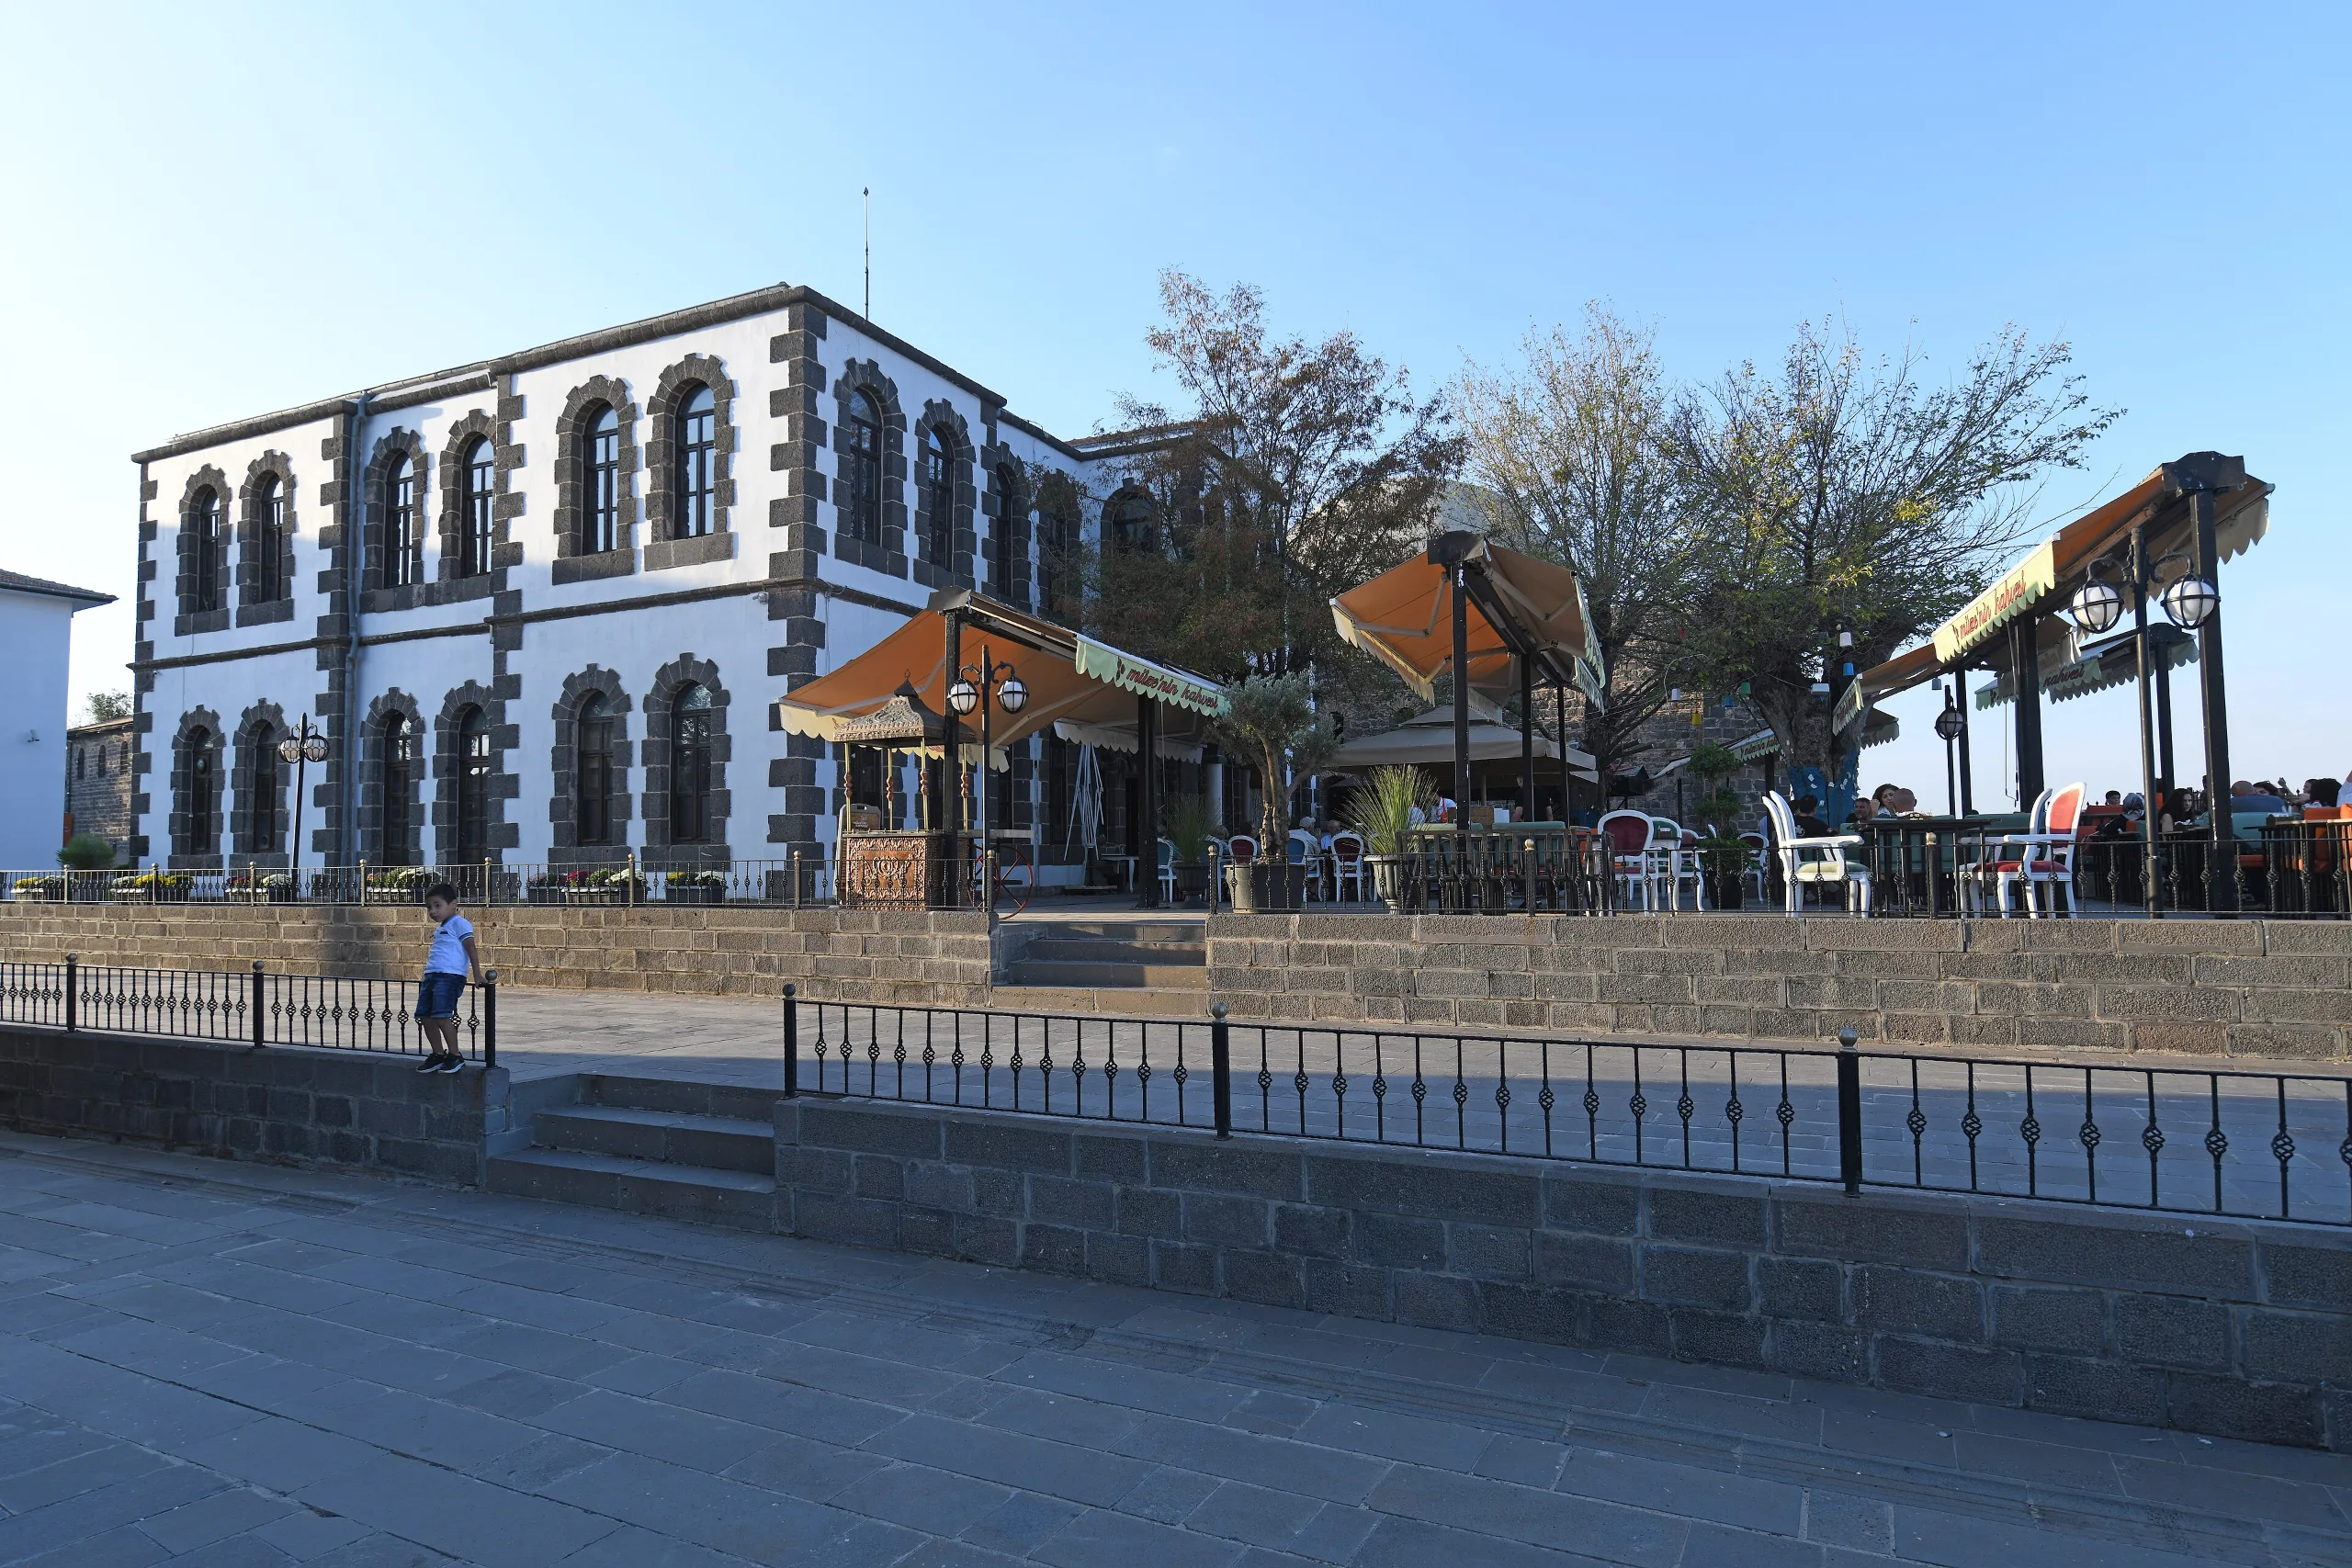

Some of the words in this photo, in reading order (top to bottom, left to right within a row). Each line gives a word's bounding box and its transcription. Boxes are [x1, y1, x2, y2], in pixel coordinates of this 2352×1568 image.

[1995, 570, 2027, 615] kahvesi
[1125, 668, 1178, 695] müze'nin
[1181, 682, 1218, 709] kahvesi
